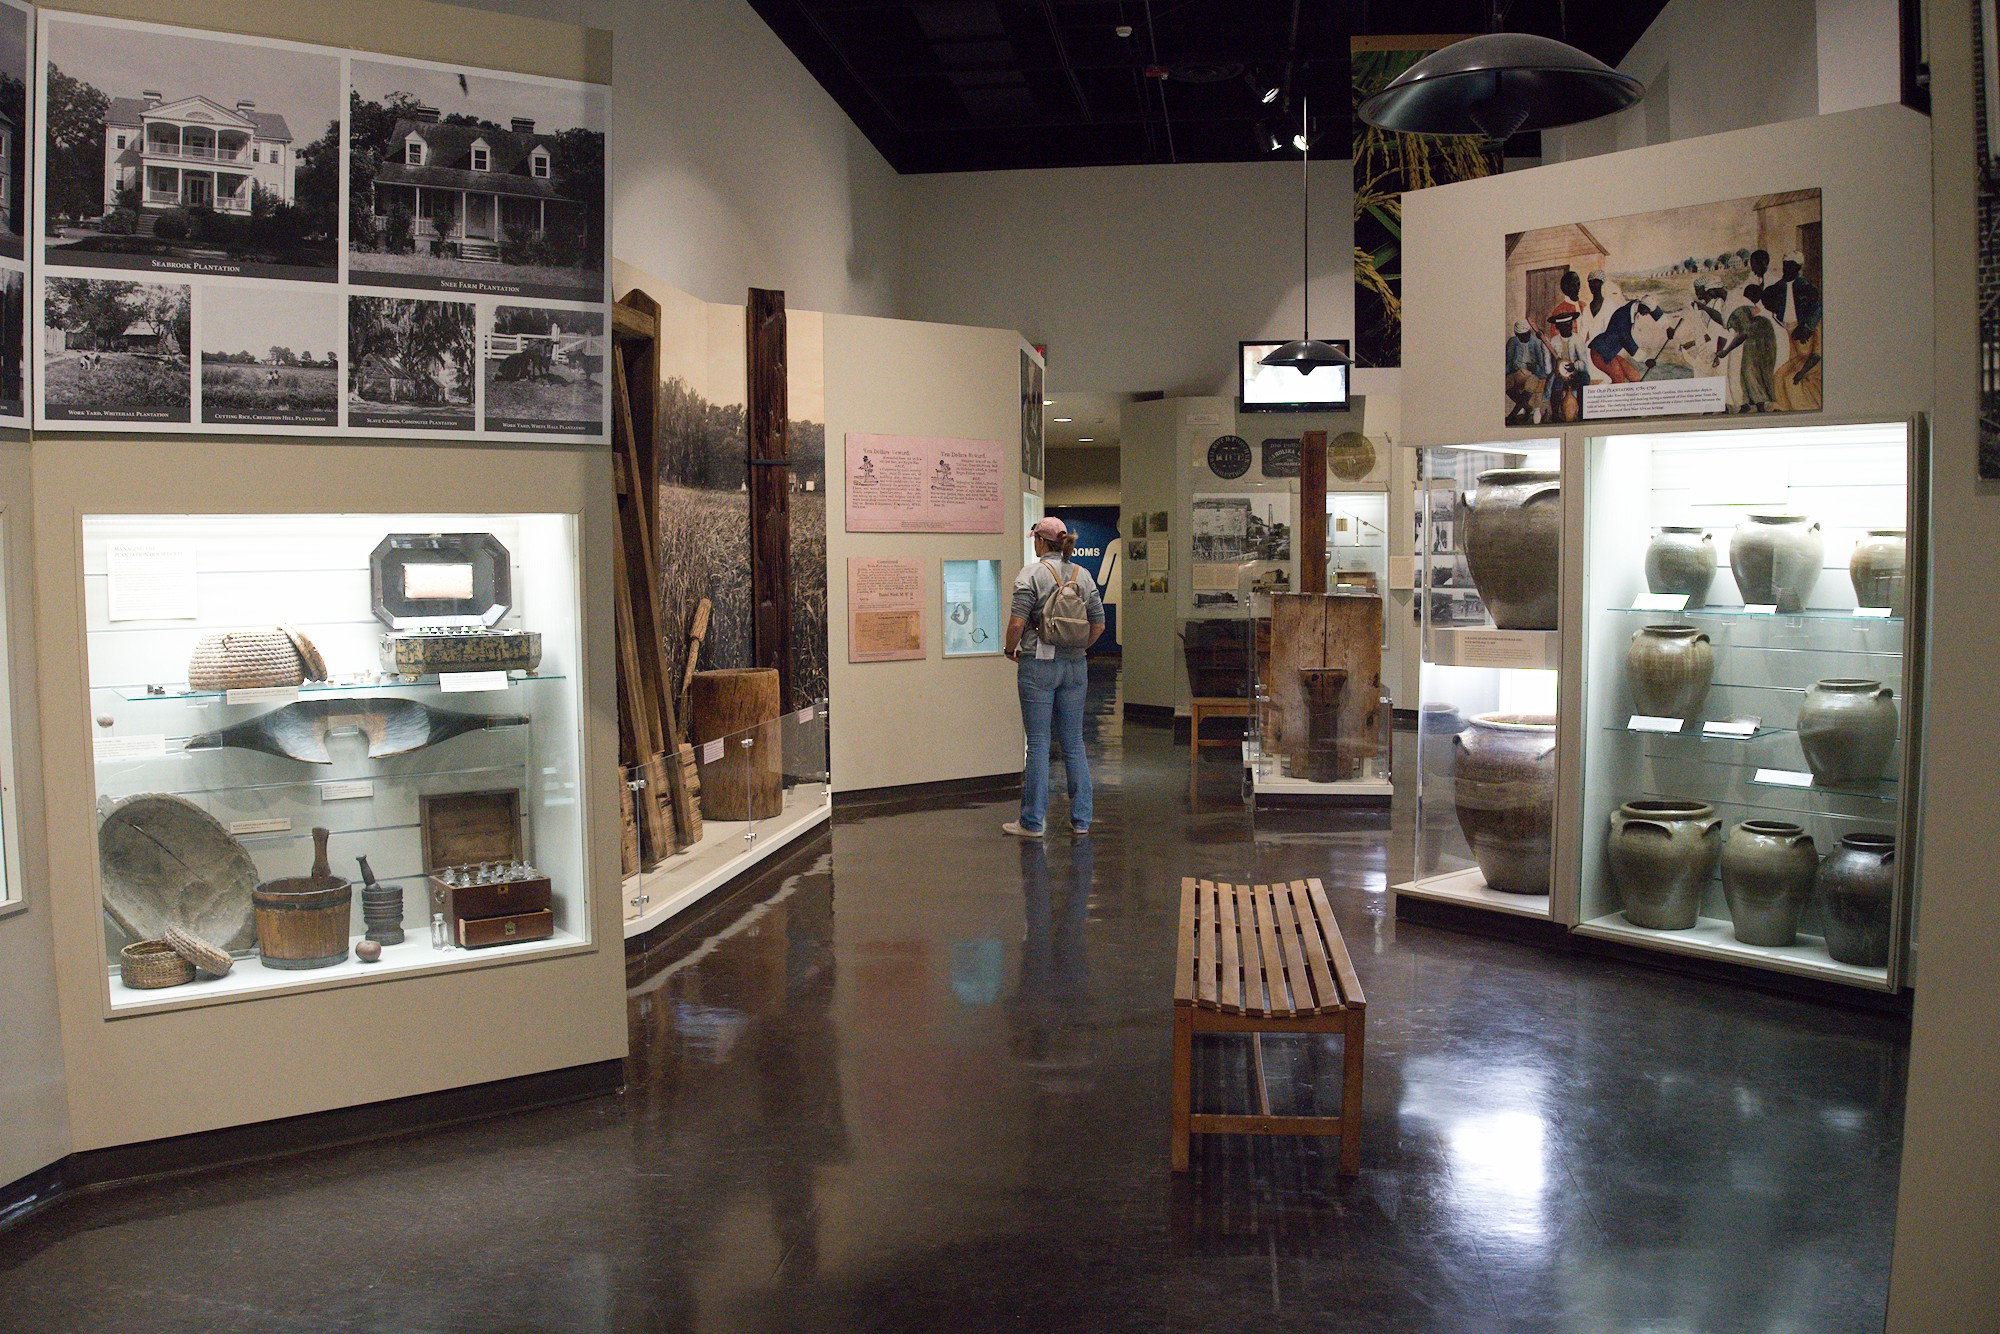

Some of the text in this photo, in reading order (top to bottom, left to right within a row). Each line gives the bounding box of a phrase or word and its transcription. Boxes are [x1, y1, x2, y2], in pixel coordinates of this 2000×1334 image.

[151, 260, 241, 272] SEABROOK PLANTATION
[479, 283, 520, 292] PLANTATION
